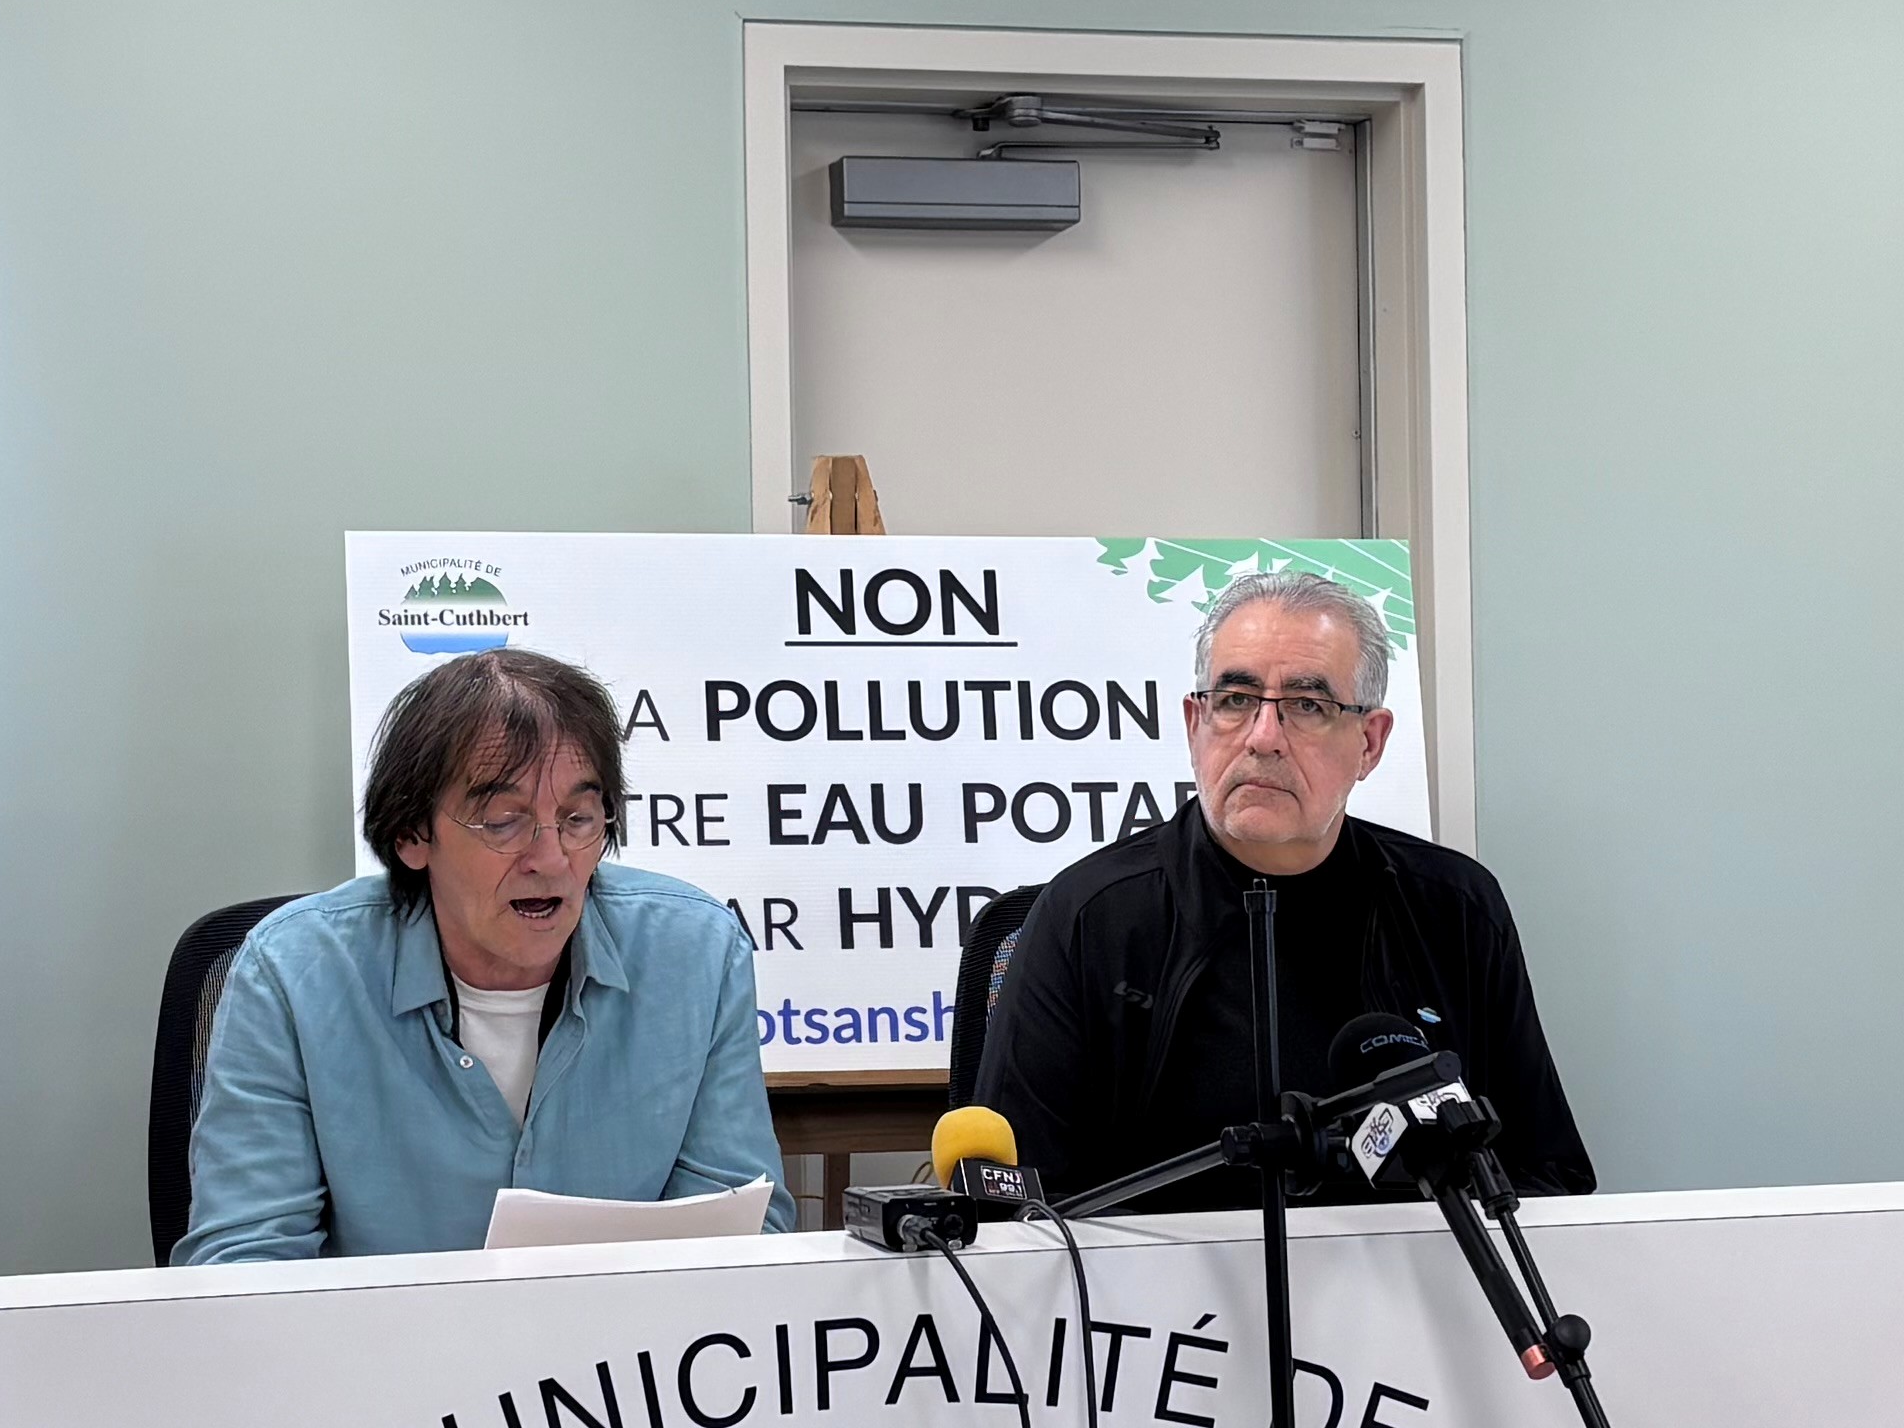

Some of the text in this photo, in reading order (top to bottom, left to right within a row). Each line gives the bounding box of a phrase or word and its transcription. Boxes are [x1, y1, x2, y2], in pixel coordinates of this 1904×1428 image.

[400, 557, 503, 578] MUNICIPALITÉ DE
[378, 608, 530, 627] Saint-Cuthbert
[795, 568, 1000, 636] NON
[623, 680, 1160, 742] A POLLUTION
[620, 793, 731, 847] TRE
[767, 783, 923, 846] EAU
[838, 886, 1003, 950] HYD
[756, 991, 956, 1046] otsansh
[982, 1168, 1023, 1183] CFNJ
